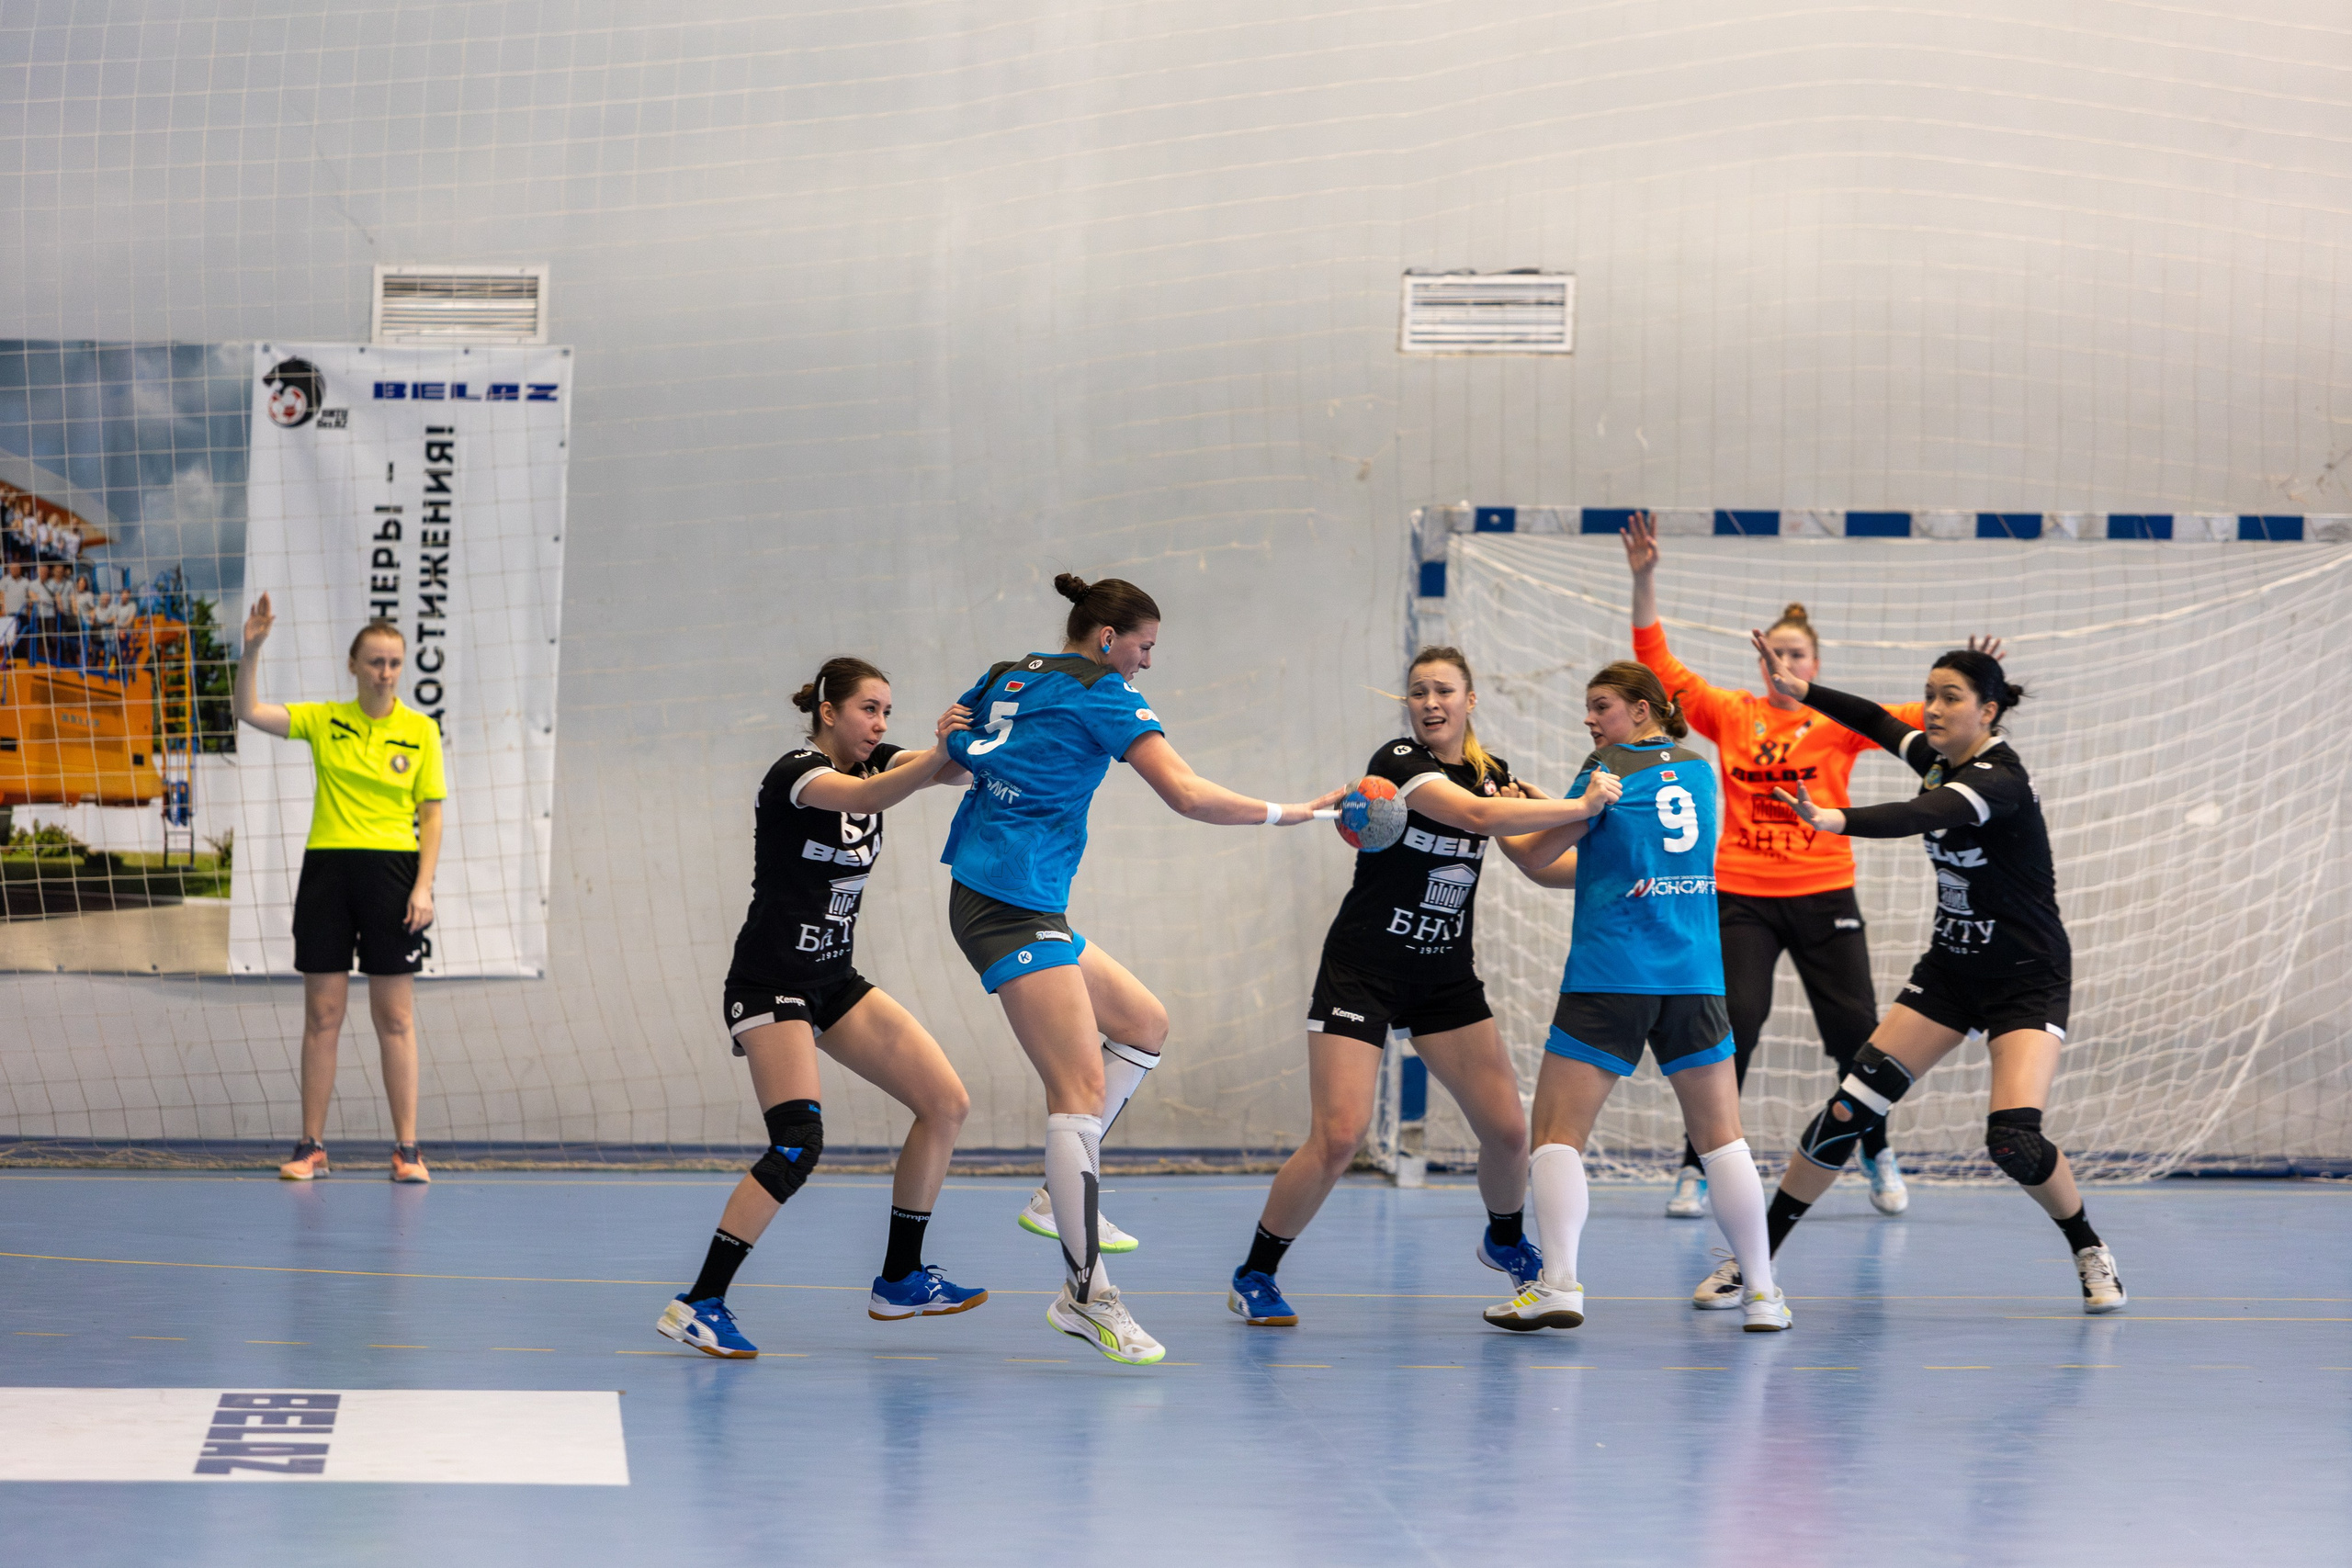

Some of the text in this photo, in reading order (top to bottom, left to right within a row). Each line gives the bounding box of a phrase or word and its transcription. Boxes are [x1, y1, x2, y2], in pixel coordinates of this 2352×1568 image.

[373, 381, 559, 402] BELAZ
[369, 505, 403, 624] НЕРЫ
[967, 701, 1020, 756] 5
[1730, 765, 1817, 782] BELAZ
[1656, 784, 1700, 853] 9
[801, 832, 882, 867] BELA
[1402, 826, 1488, 860] BEL
[1331, 1007, 1365, 1022] Kempa
[193, 1393, 342, 1475] BELAZ
